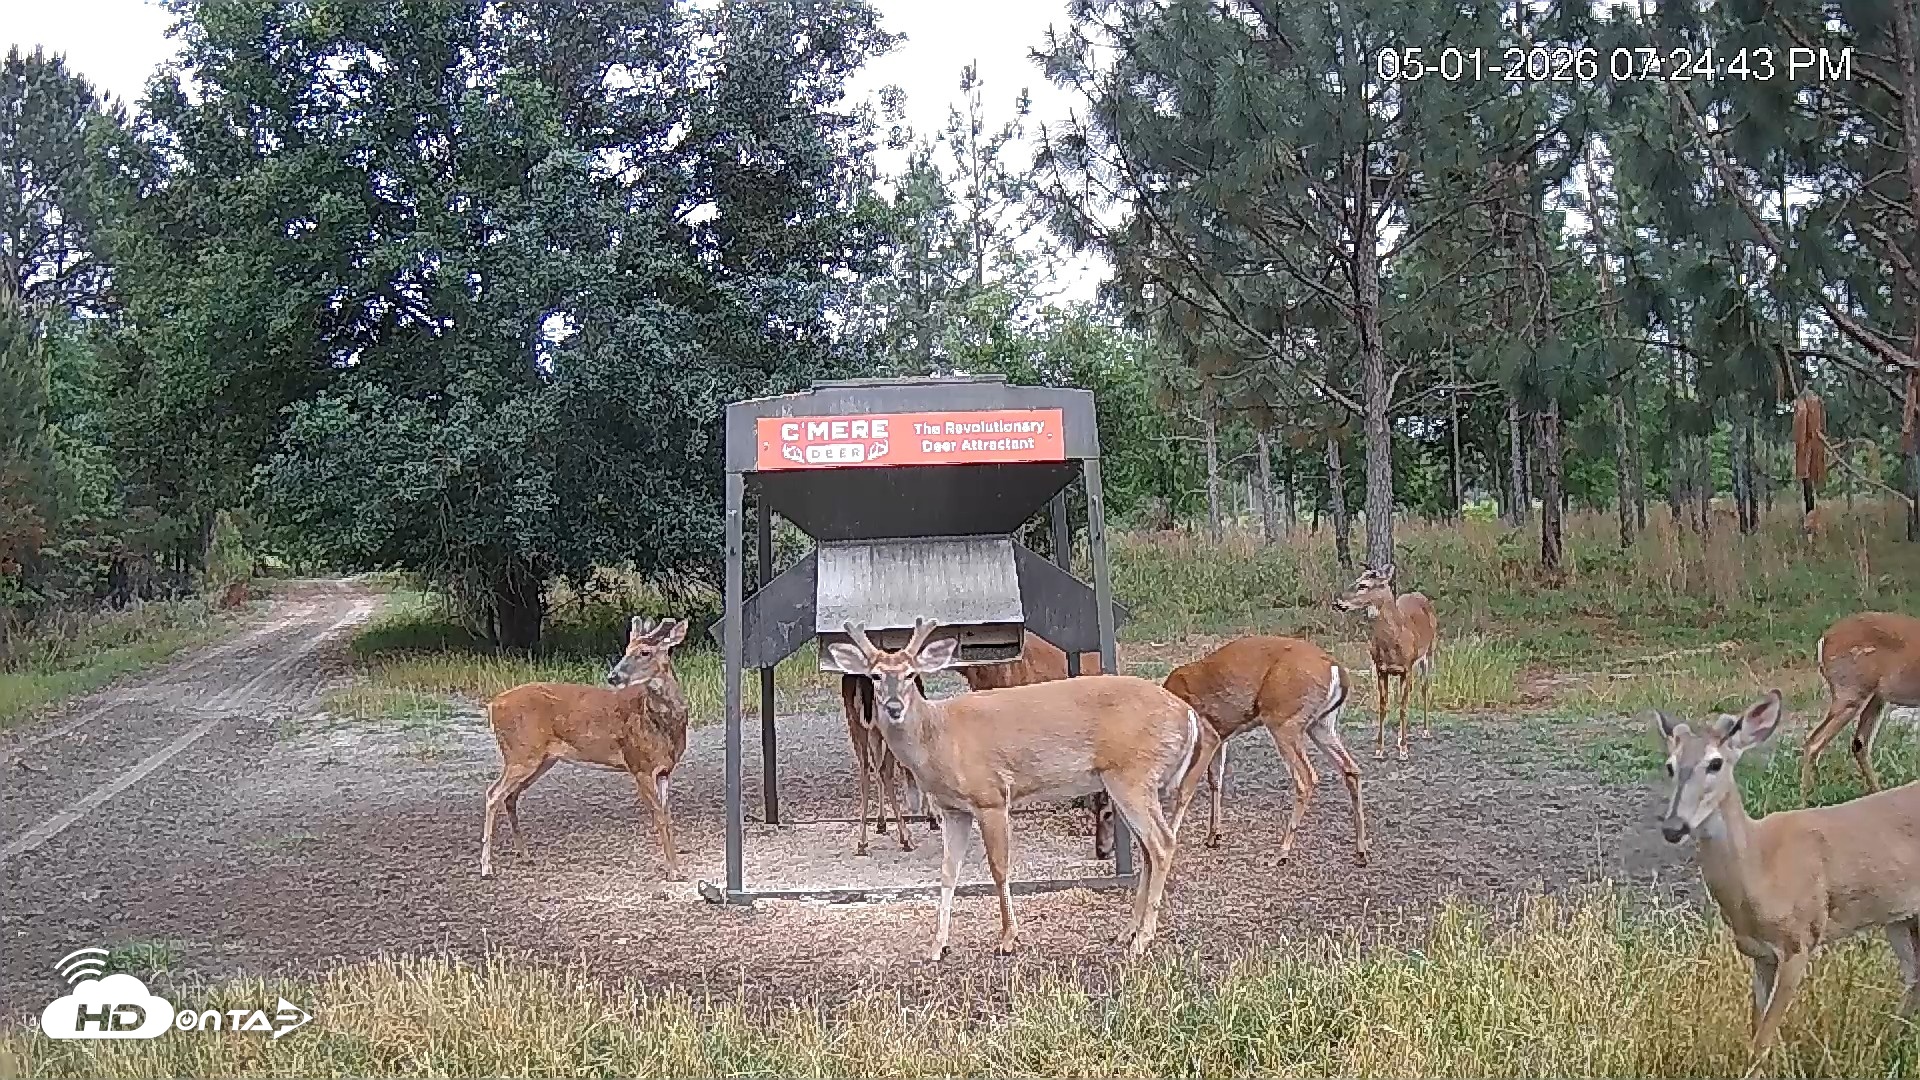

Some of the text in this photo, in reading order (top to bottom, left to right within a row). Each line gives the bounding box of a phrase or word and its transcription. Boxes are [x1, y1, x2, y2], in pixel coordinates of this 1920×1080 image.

[781, 419, 889, 442] C'MERE
[913, 419, 1045, 436] The Revolutionary
[811, 445, 864, 460] DEER
[922, 437, 1035, 453] Deer Attractant
